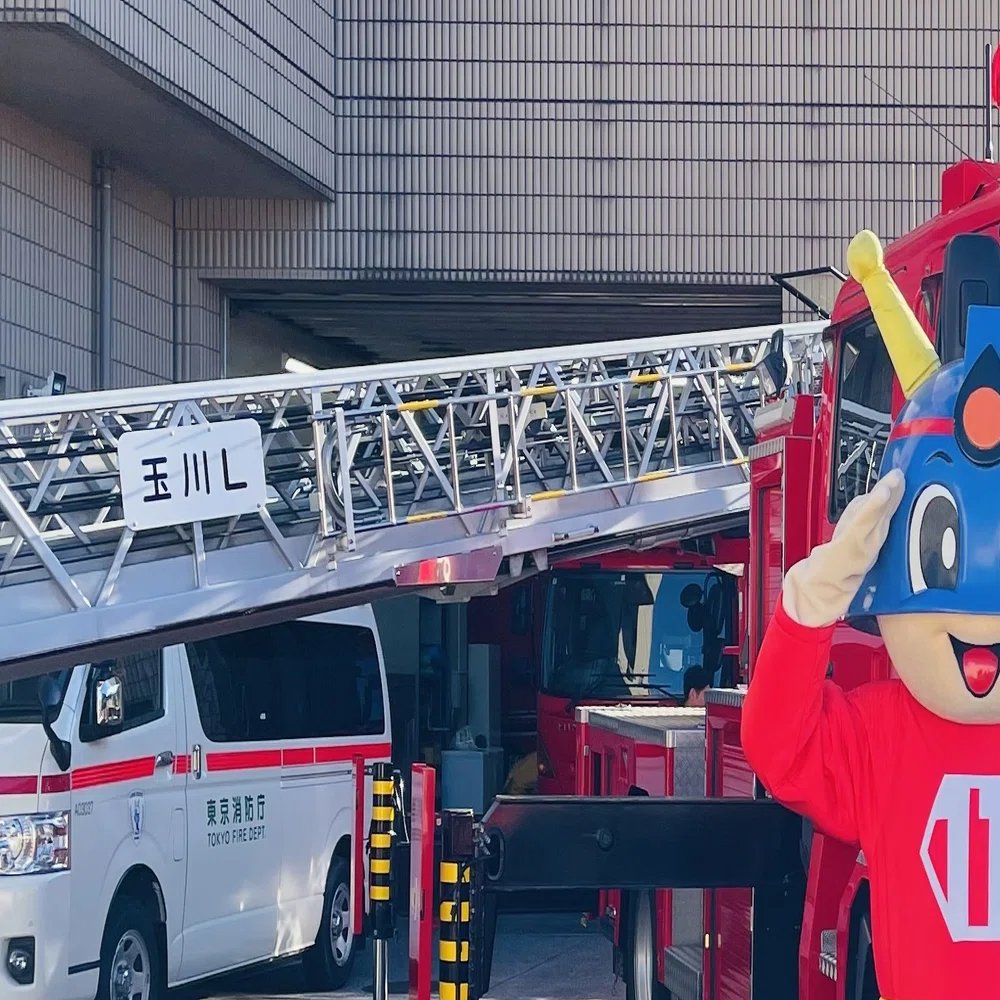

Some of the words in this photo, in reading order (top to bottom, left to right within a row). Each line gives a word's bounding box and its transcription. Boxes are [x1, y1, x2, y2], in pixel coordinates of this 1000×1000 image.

[141, 447, 248, 503] 玉川L
[206, 794, 266, 827] 東京消防庁
[207, 831, 230, 847] TOKYO
[232, 828, 247, 844] FIRE
